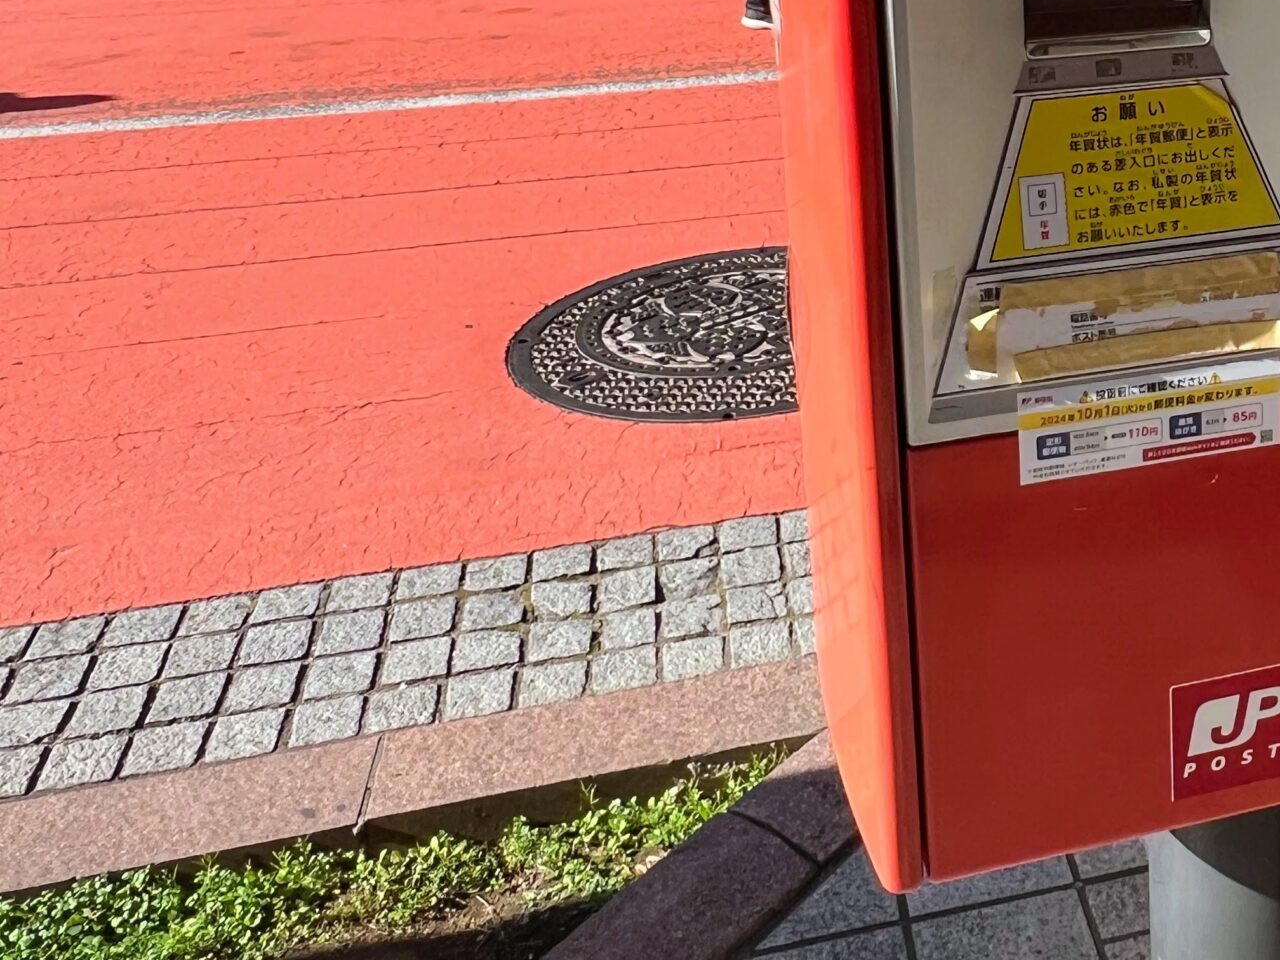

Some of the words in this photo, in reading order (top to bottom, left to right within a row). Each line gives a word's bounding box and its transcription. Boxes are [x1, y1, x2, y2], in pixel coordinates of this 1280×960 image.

[1091, 101, 1165, 122] お願い
[1232, 411, 1257, 423] 85円
[1128, 426, 1159, 439] 110円
